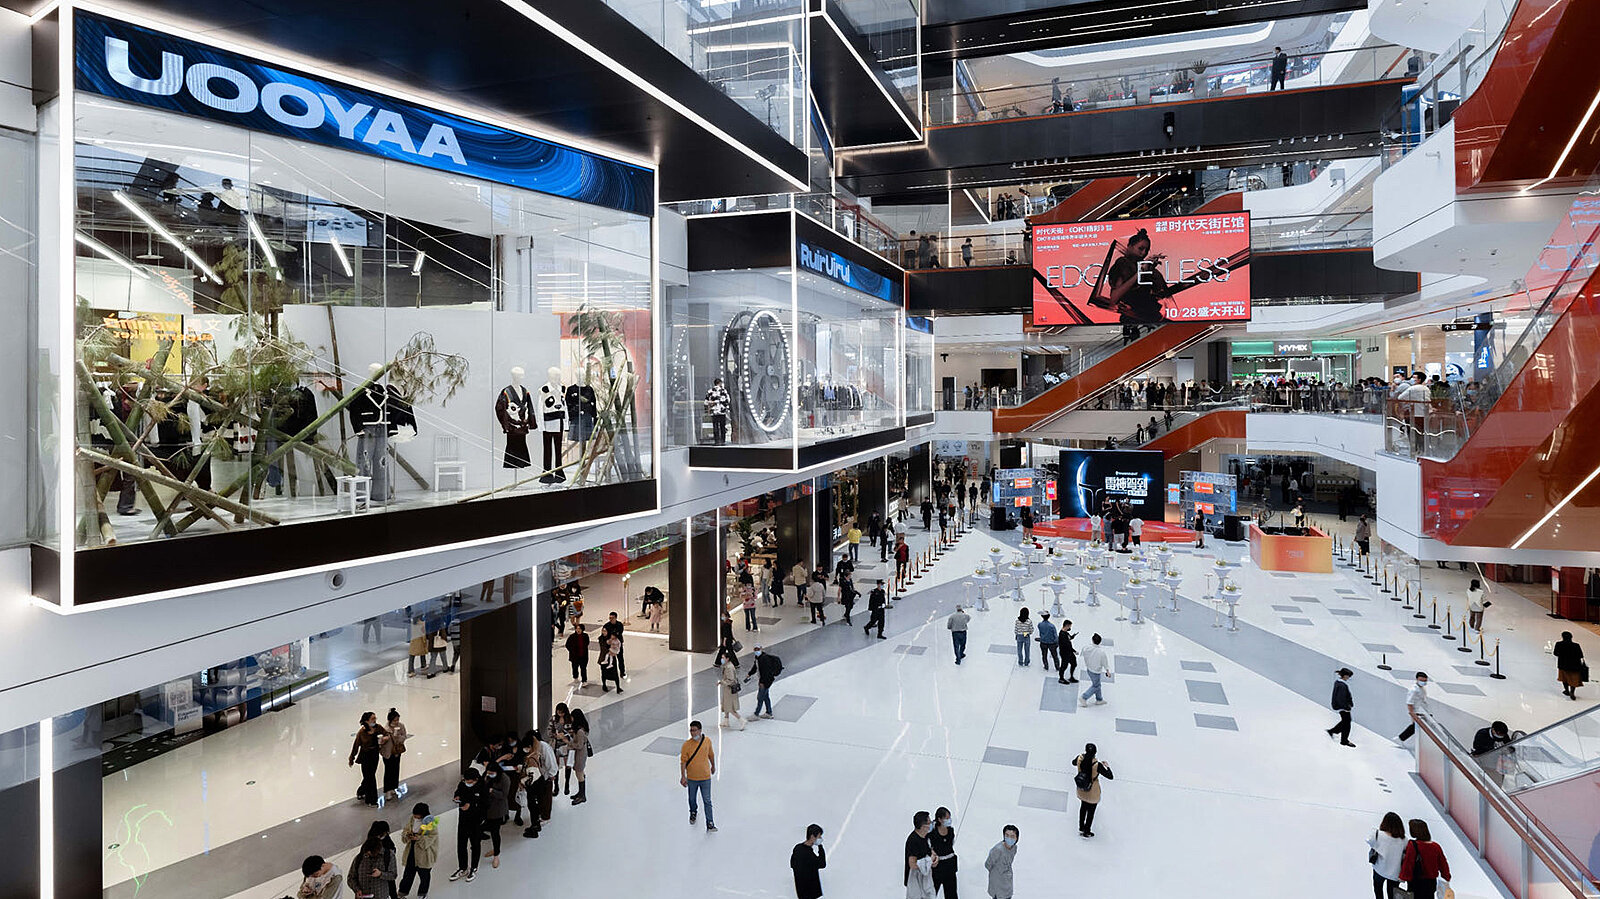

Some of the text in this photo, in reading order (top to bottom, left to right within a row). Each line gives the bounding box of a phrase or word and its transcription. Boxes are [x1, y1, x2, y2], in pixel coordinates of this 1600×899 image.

[104, 36, 468, 166] UOOYAA
[1168, 216, 1245, 232] 时代天街E馆
[1278, 344, 1308, 352] MYMIX
